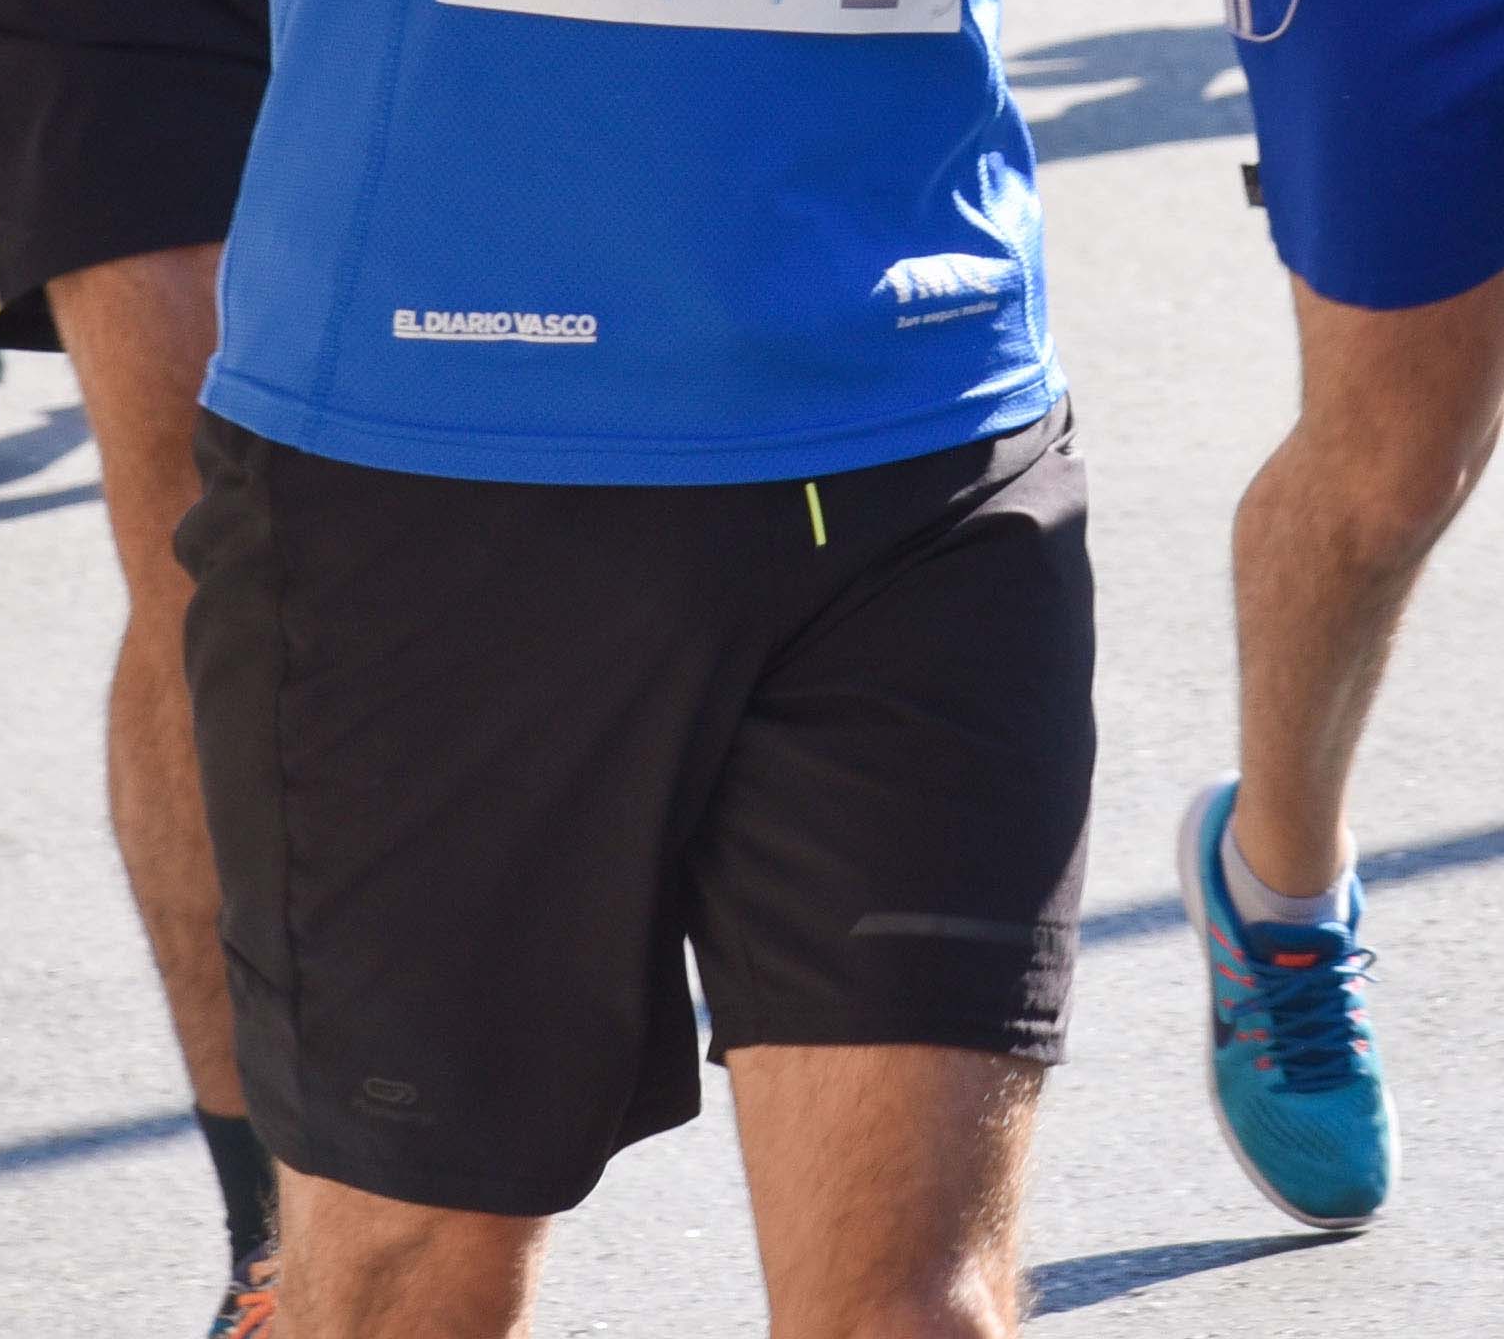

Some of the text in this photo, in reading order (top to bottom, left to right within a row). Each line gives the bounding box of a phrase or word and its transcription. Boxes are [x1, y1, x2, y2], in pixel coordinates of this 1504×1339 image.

[394, 309, 596, 336] EL DIARIO VASCO
